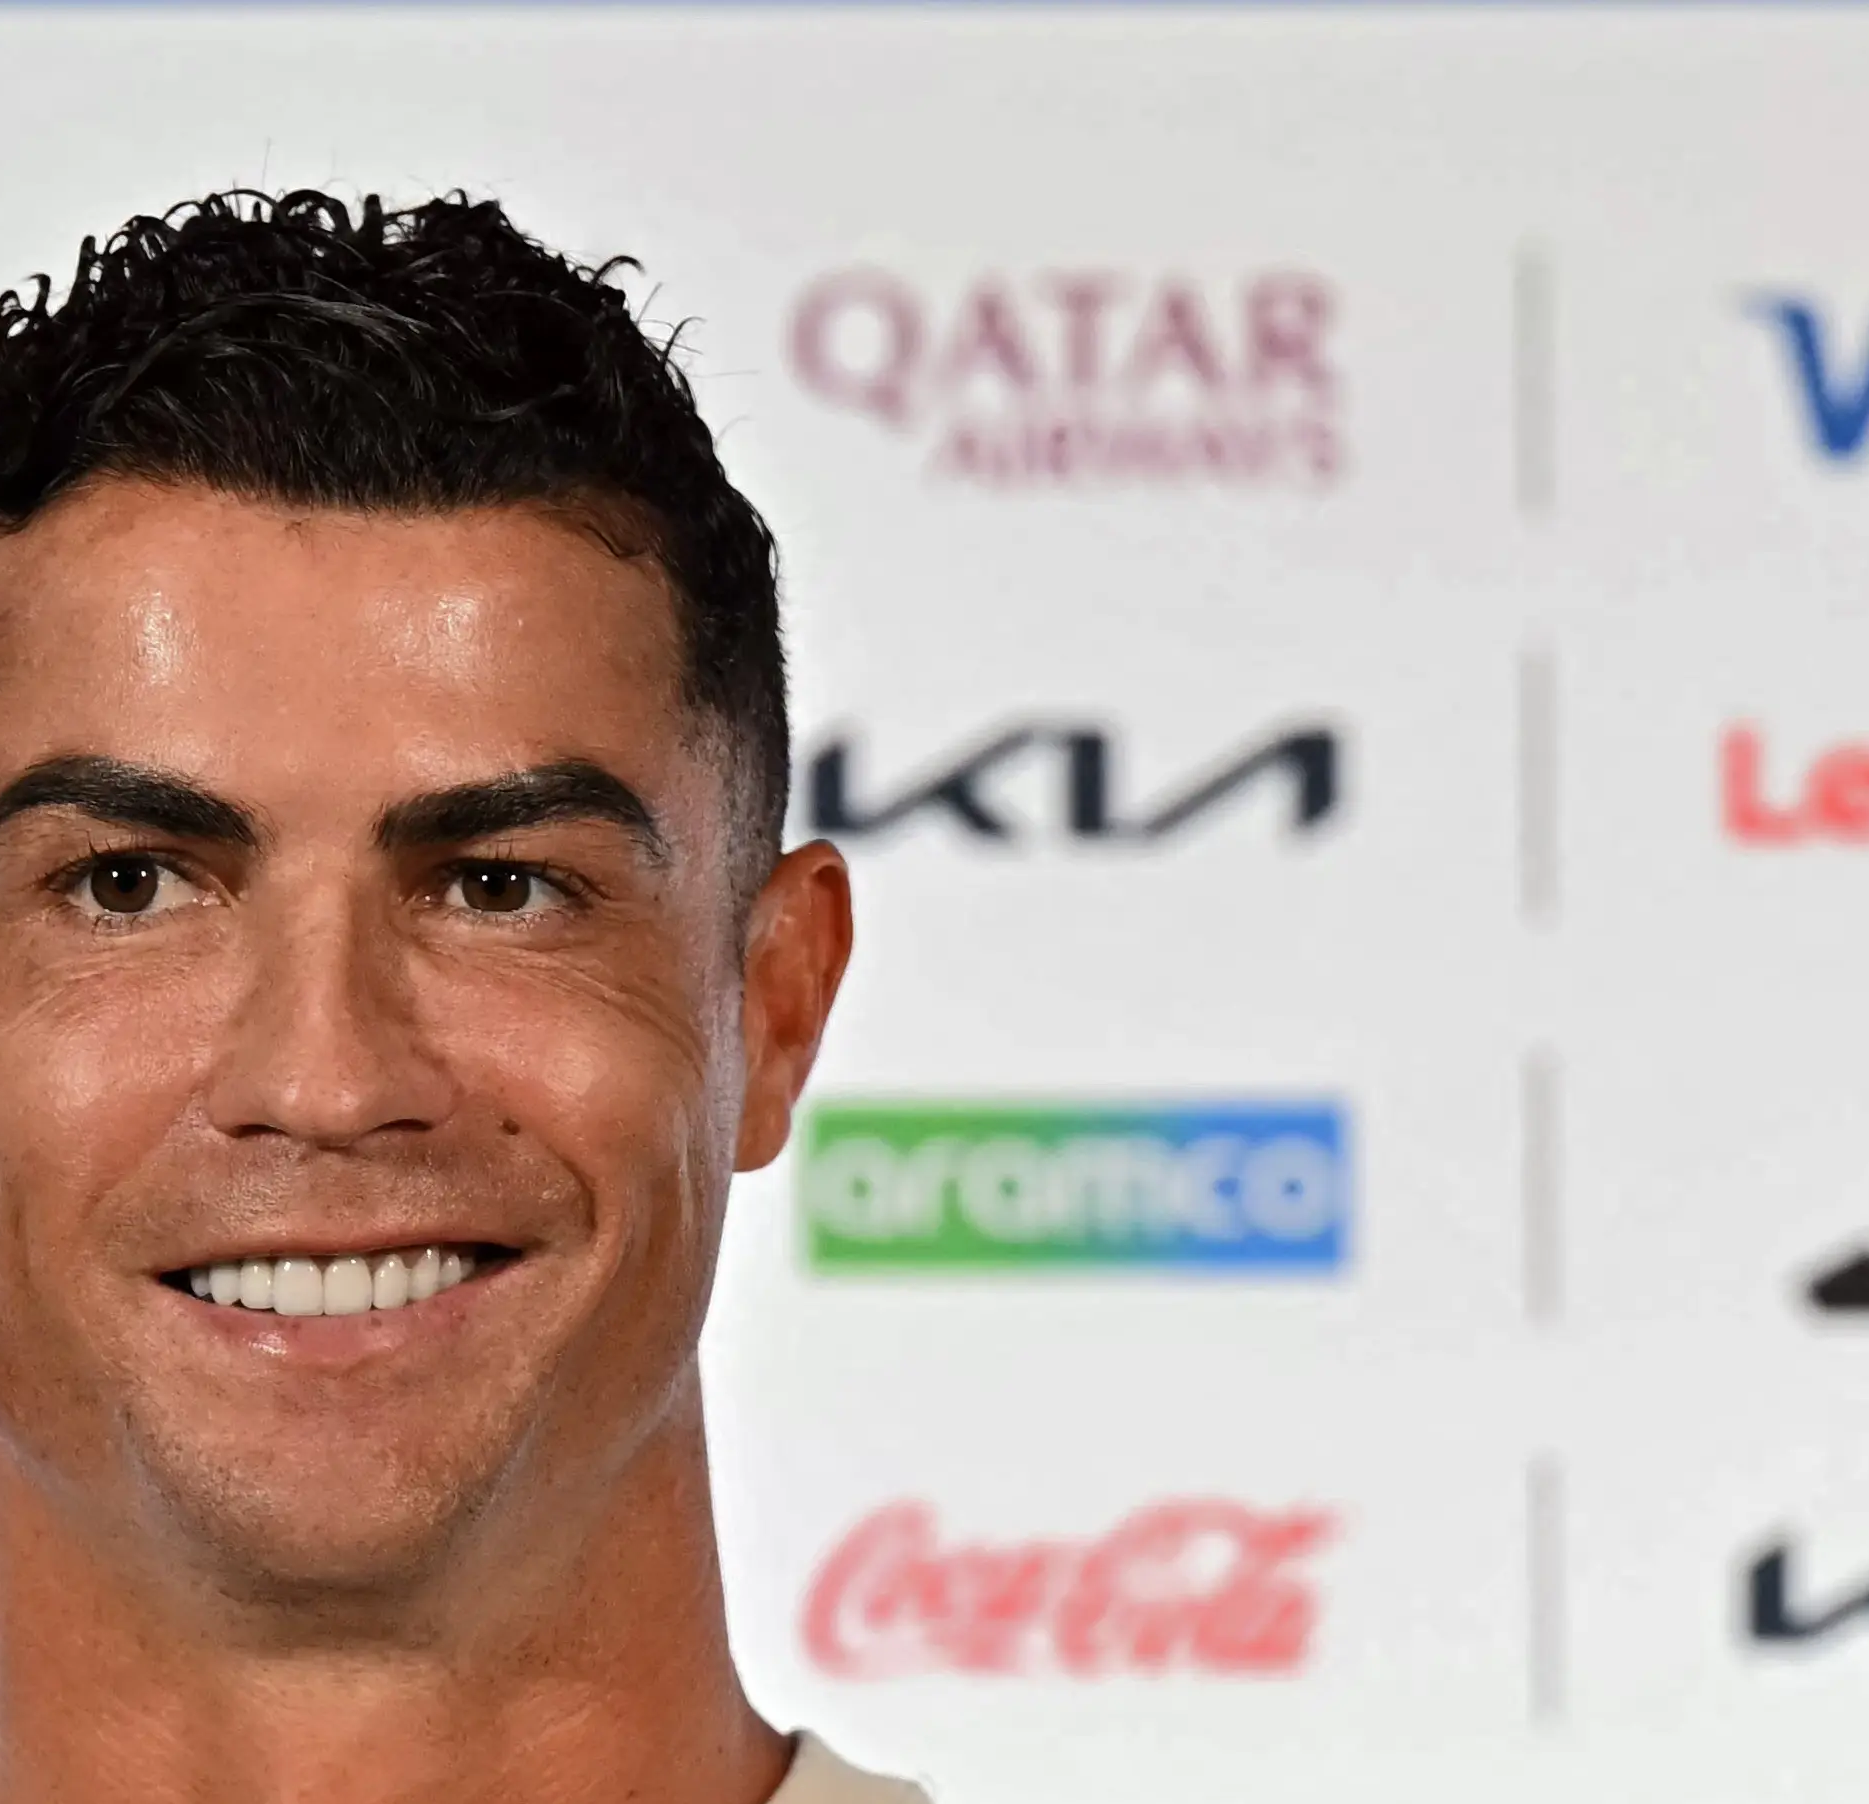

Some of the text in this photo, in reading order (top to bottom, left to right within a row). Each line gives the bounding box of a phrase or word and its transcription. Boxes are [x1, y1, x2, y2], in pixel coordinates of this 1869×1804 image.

[788, 273, 1338, 428] QATAR
[814, 1133, 1334, 1243] aramco
[799, 1499, 1339, 1678] Coca-Cola
